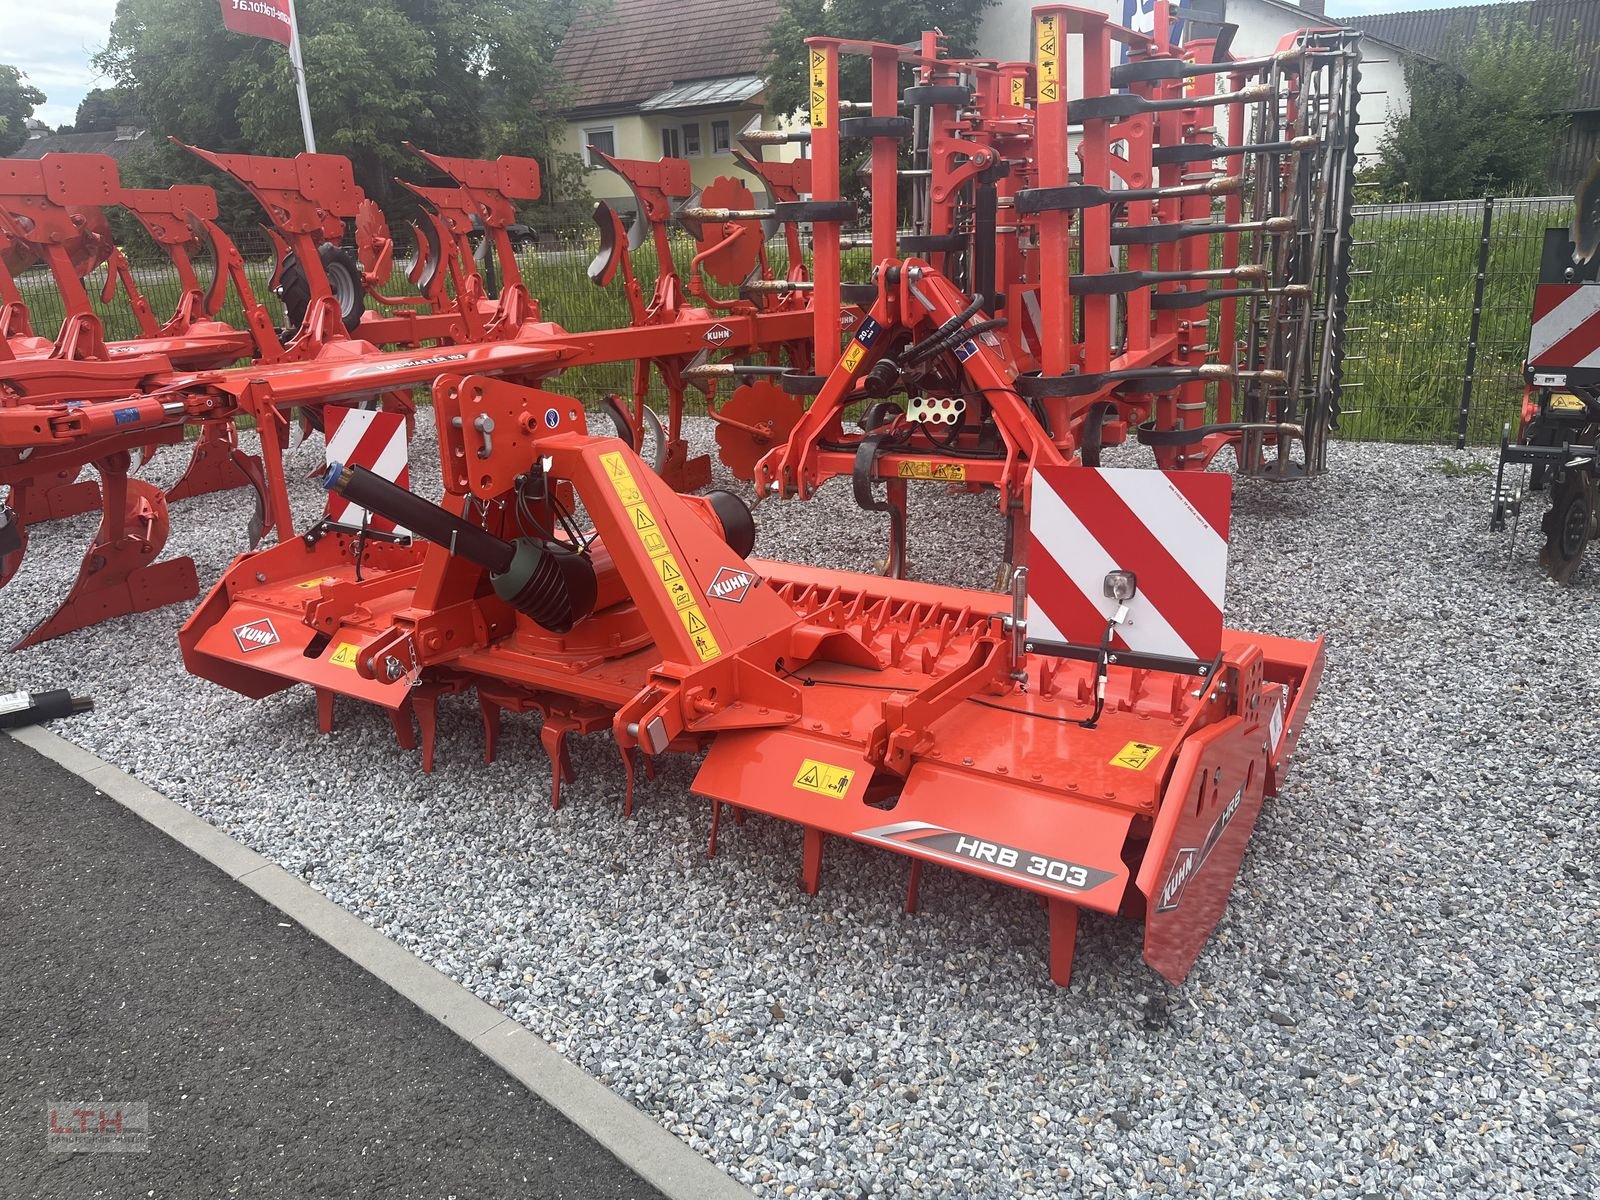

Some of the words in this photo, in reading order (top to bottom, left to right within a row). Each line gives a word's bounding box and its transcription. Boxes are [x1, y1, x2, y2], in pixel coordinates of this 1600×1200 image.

[707, 330, 730, 340] KUHN
[712, 573, 750, 597] KUHN
[238, 626, 275, 645] KUHN
[1221, 789, 1241, 827] HRB
[955, 836, 1019, 868] HRB
[1026, 855, 1089, 887] 303
[1163, 852, 1193, 907] KUHN
